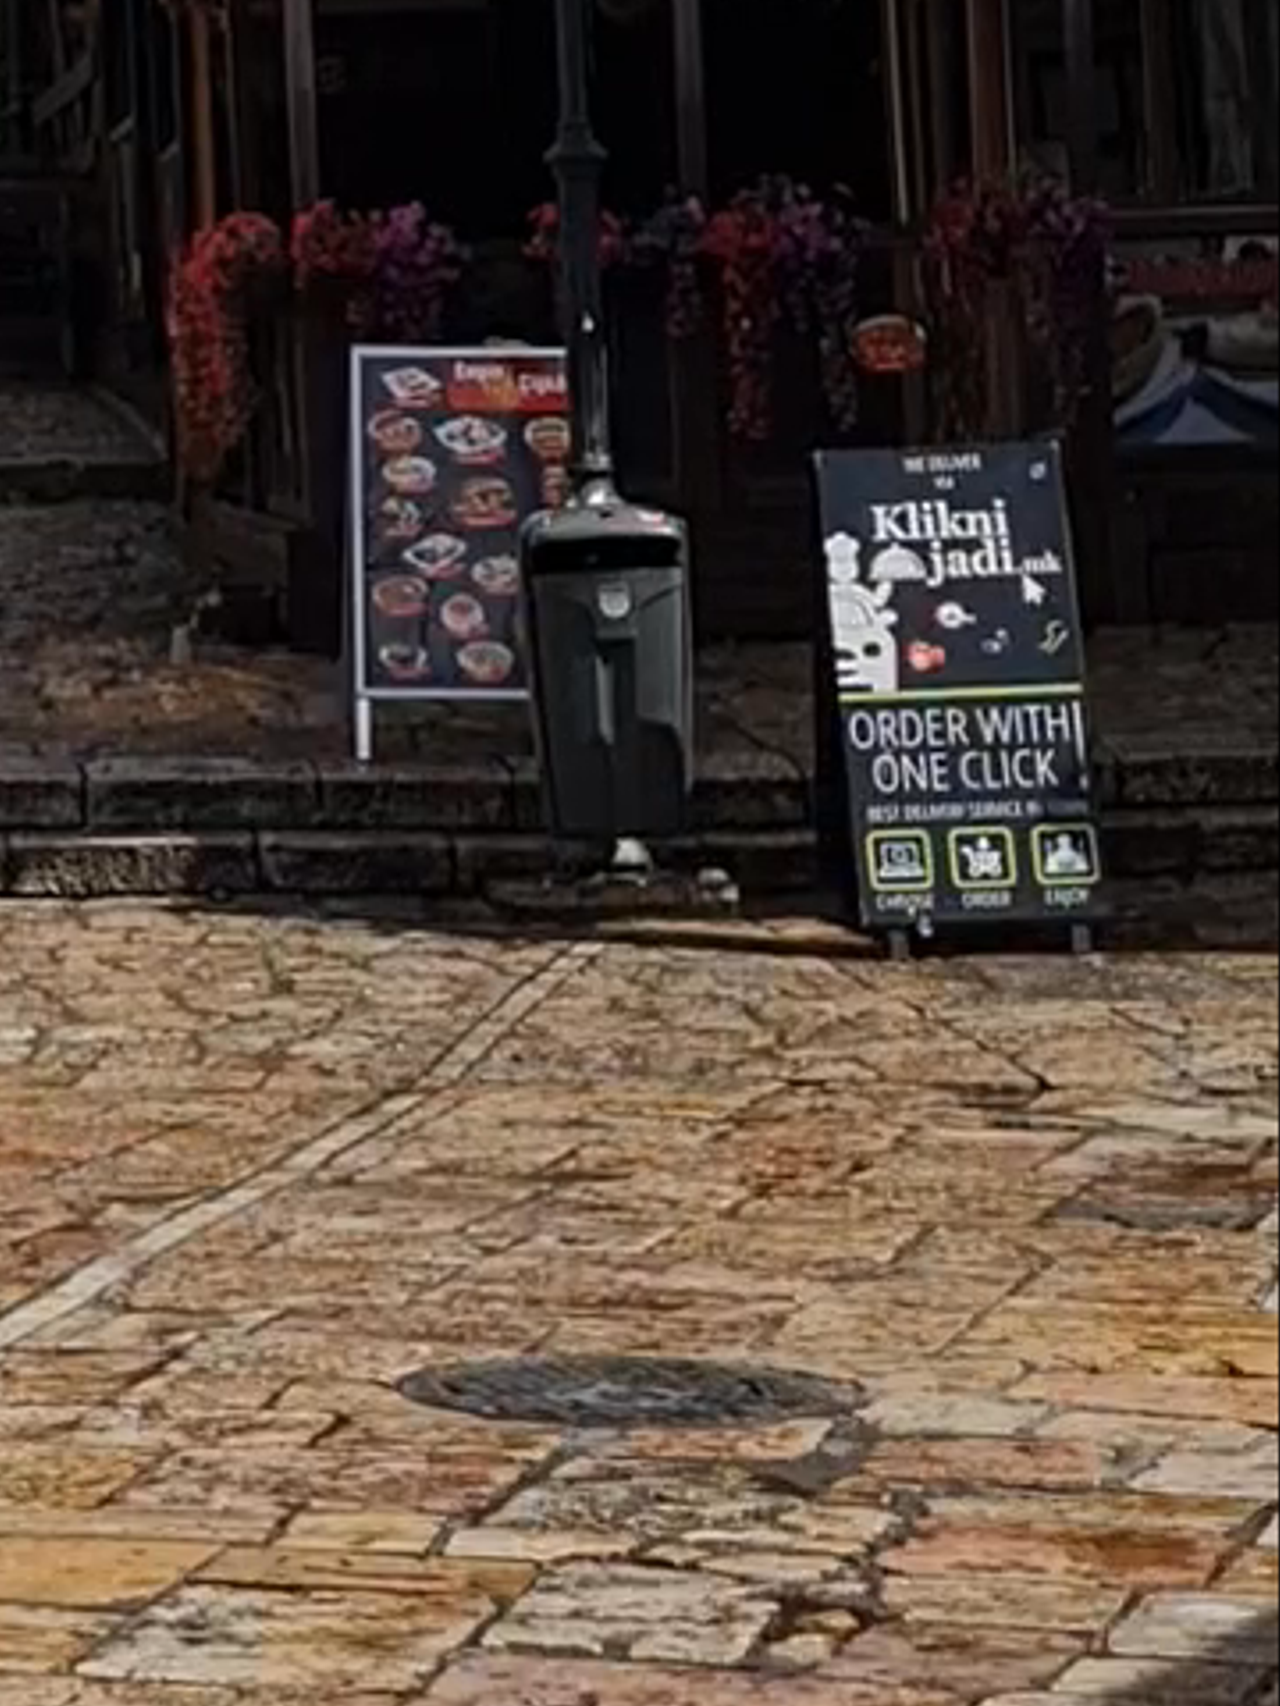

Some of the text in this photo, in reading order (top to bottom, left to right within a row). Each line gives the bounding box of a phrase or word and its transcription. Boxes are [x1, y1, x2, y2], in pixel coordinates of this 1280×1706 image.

[870, 498, 1009, 541] Klikni
[848, 709, 970, 750] ORDER
[974, 703, 1071, 745] WITH
[872, 748, 1059, 793] ONE CLICK
